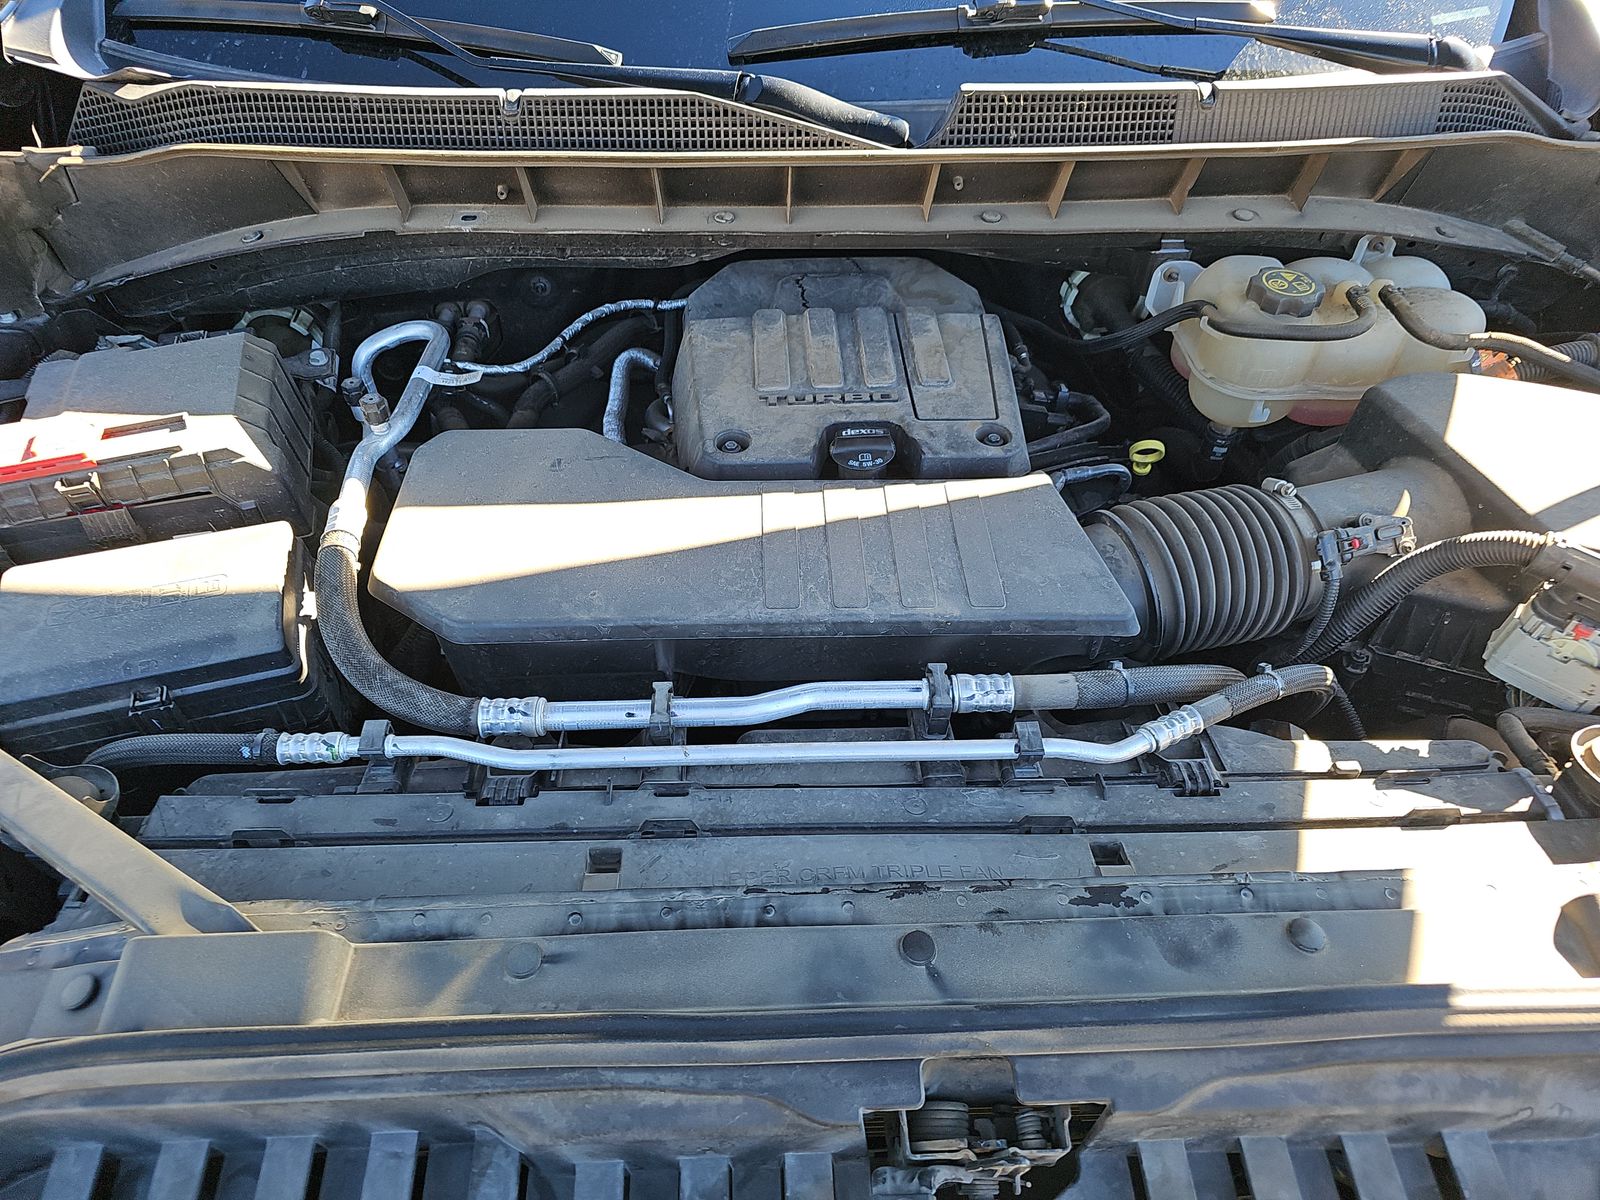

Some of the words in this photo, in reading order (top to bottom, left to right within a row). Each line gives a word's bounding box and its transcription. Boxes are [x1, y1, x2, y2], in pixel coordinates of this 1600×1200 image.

[758, 392, 899, 406] TURBO
[842, 428, 884, 436] dexos
[847, 459, 860, 467] SAE
[862, 457, 884, 467] 5W-30
[872, 864, 954, 879] TRIPLE
[960, 865, 1003, 879] FAN
